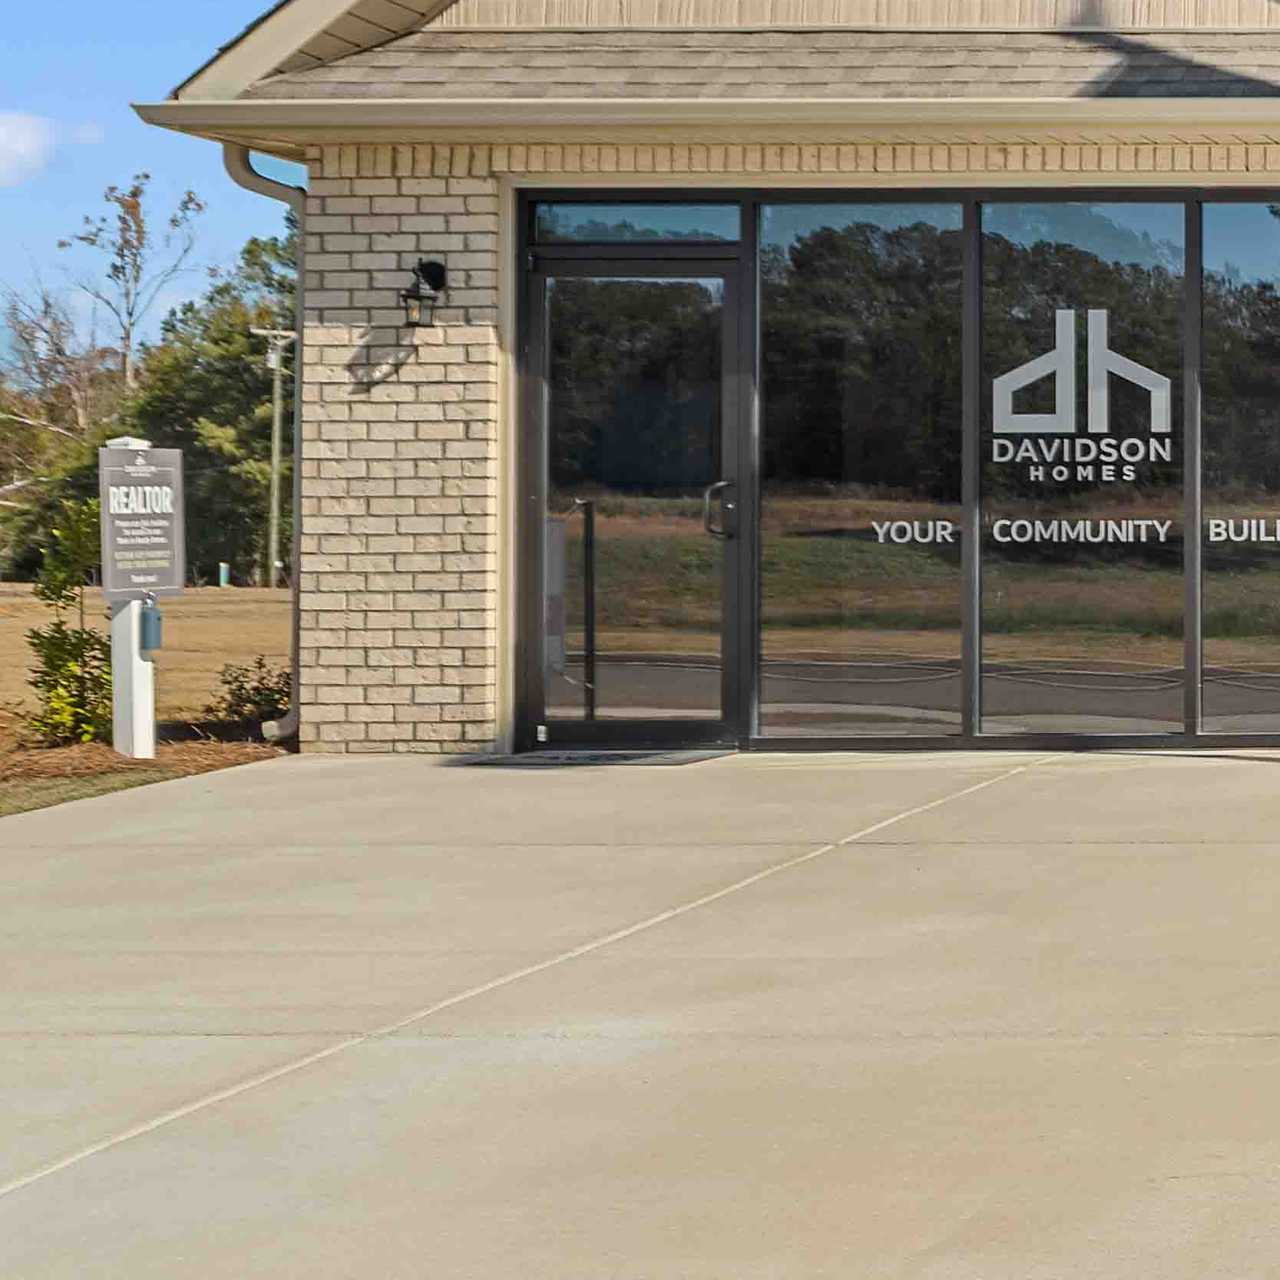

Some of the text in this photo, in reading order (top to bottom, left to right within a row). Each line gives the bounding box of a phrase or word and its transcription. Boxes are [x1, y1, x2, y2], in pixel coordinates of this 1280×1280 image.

[992, 437, 1171, 463] DAVIDSON
[1029, 464, 1136, 482] HOMES
[109, 486, 174, 514] REALTOR
[871, 520, 954, 543] YOUR
[993, 519, 1172, 543] COMMUNITY
